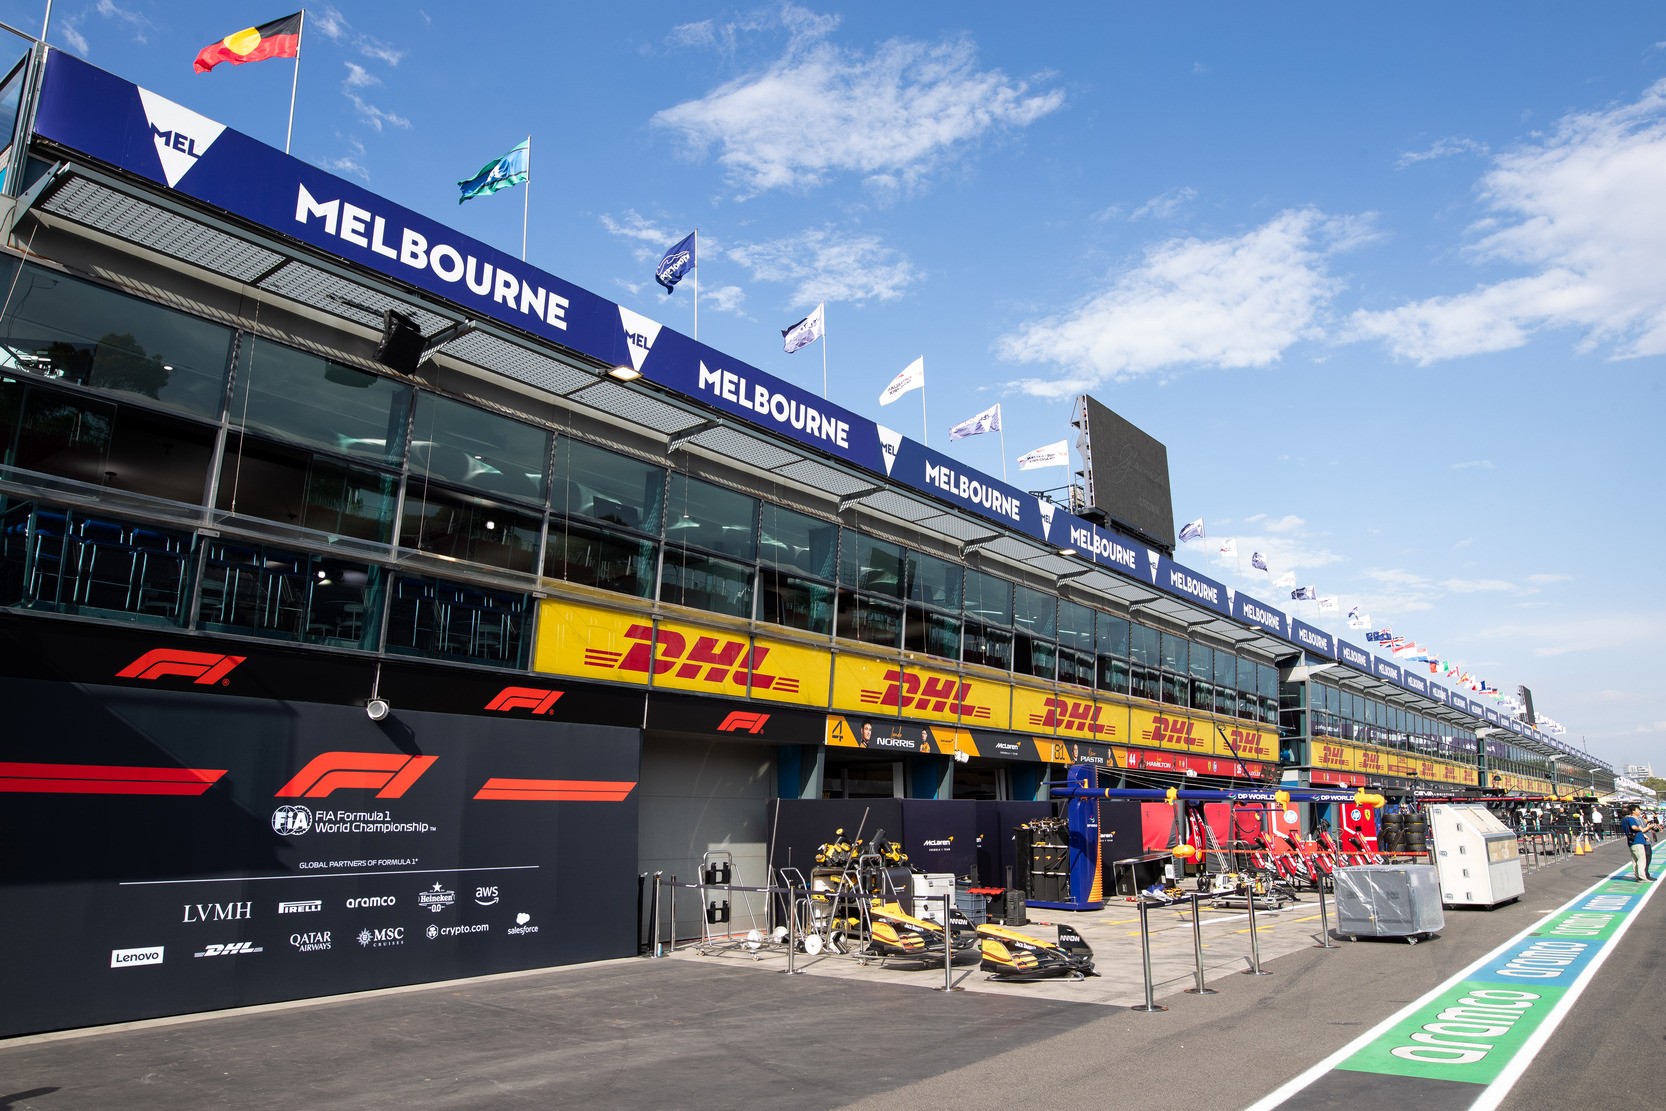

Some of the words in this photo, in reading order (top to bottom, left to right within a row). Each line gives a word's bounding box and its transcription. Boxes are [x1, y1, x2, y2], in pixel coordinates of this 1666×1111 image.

[149, 122, 202, 159] MEL
[295, 182, 571, 332] MELBOURNE
[624, 329, 651, 351] MEL
[699, 360, 850, 450] MELBOURNE
[880, 441, 897, 457] MEL
[925, 459, 1021, 522] MELBOURNE
[1071, 524, 1136, 570] MELBOURNE
[1170, 569, 1218, 604] MELBOURNE
[1243, 602, 1280, 630] MELBOURNE
[1299, 627, 1328, 651] MELBOURNE
[618, 624, 776, 689] DHL
[879, 669, 976, 716] DHL
[1042, 696, 1105, 734] DHL
[831, 721, 844, 742] 4
[876, 737, 915, 748] NORRIS
[1151, 715, 1197, 747] DHL
[1230, 729, 1264, 754] DHL
[995, 742, 1019, 750] McLaren
[1323, 745, 1346, 765] DHL
[1080, 755, 1104, 764] PIASTRI
[1128, 753, 1136, 766] 44
[1146, 760, 1171, 768] HAMILTON
[1363, 752, 1380, 770] DHL
[274, 751, 439, 798] F1
[315, 811, 335, 821] FIA
[337, 810, 383, 822] Formula
[384, 811, 392, 821] 1
[315, 822, 350, 833] World
[351, 822, 429, 833] Championship
[299, 861, 328, 869] GLOBAL
[329, 860, 367, 868] PARTNERS
[367, 859, 377, 867] OF
[378, 858, 411, 866] FORMULA
[182, 902, 253, 923] LVMH
[278, 900, 323, 914] PIRELLI
[346, 896, 396, 909] aramco
[420, 893, 454, 904] Heineken
[475, 886, 499, 898] aws
[115, 951, 160, 964] Lenovo
[203, 941, 254, 958] DHL
[290, 931, 332, 947] QATAR
[373, 927, 404, 942] MSC
[440, 923, 490, 936] crypto.com
[507, 925, 539, 936] salesforce
[298, 942, 332, 952] AIRWAYS
[373, 940, 404, 948] CRUISES
[1495, 941, 1589, 978] aramco
[1390, 989, 1542, 1065] aramco
